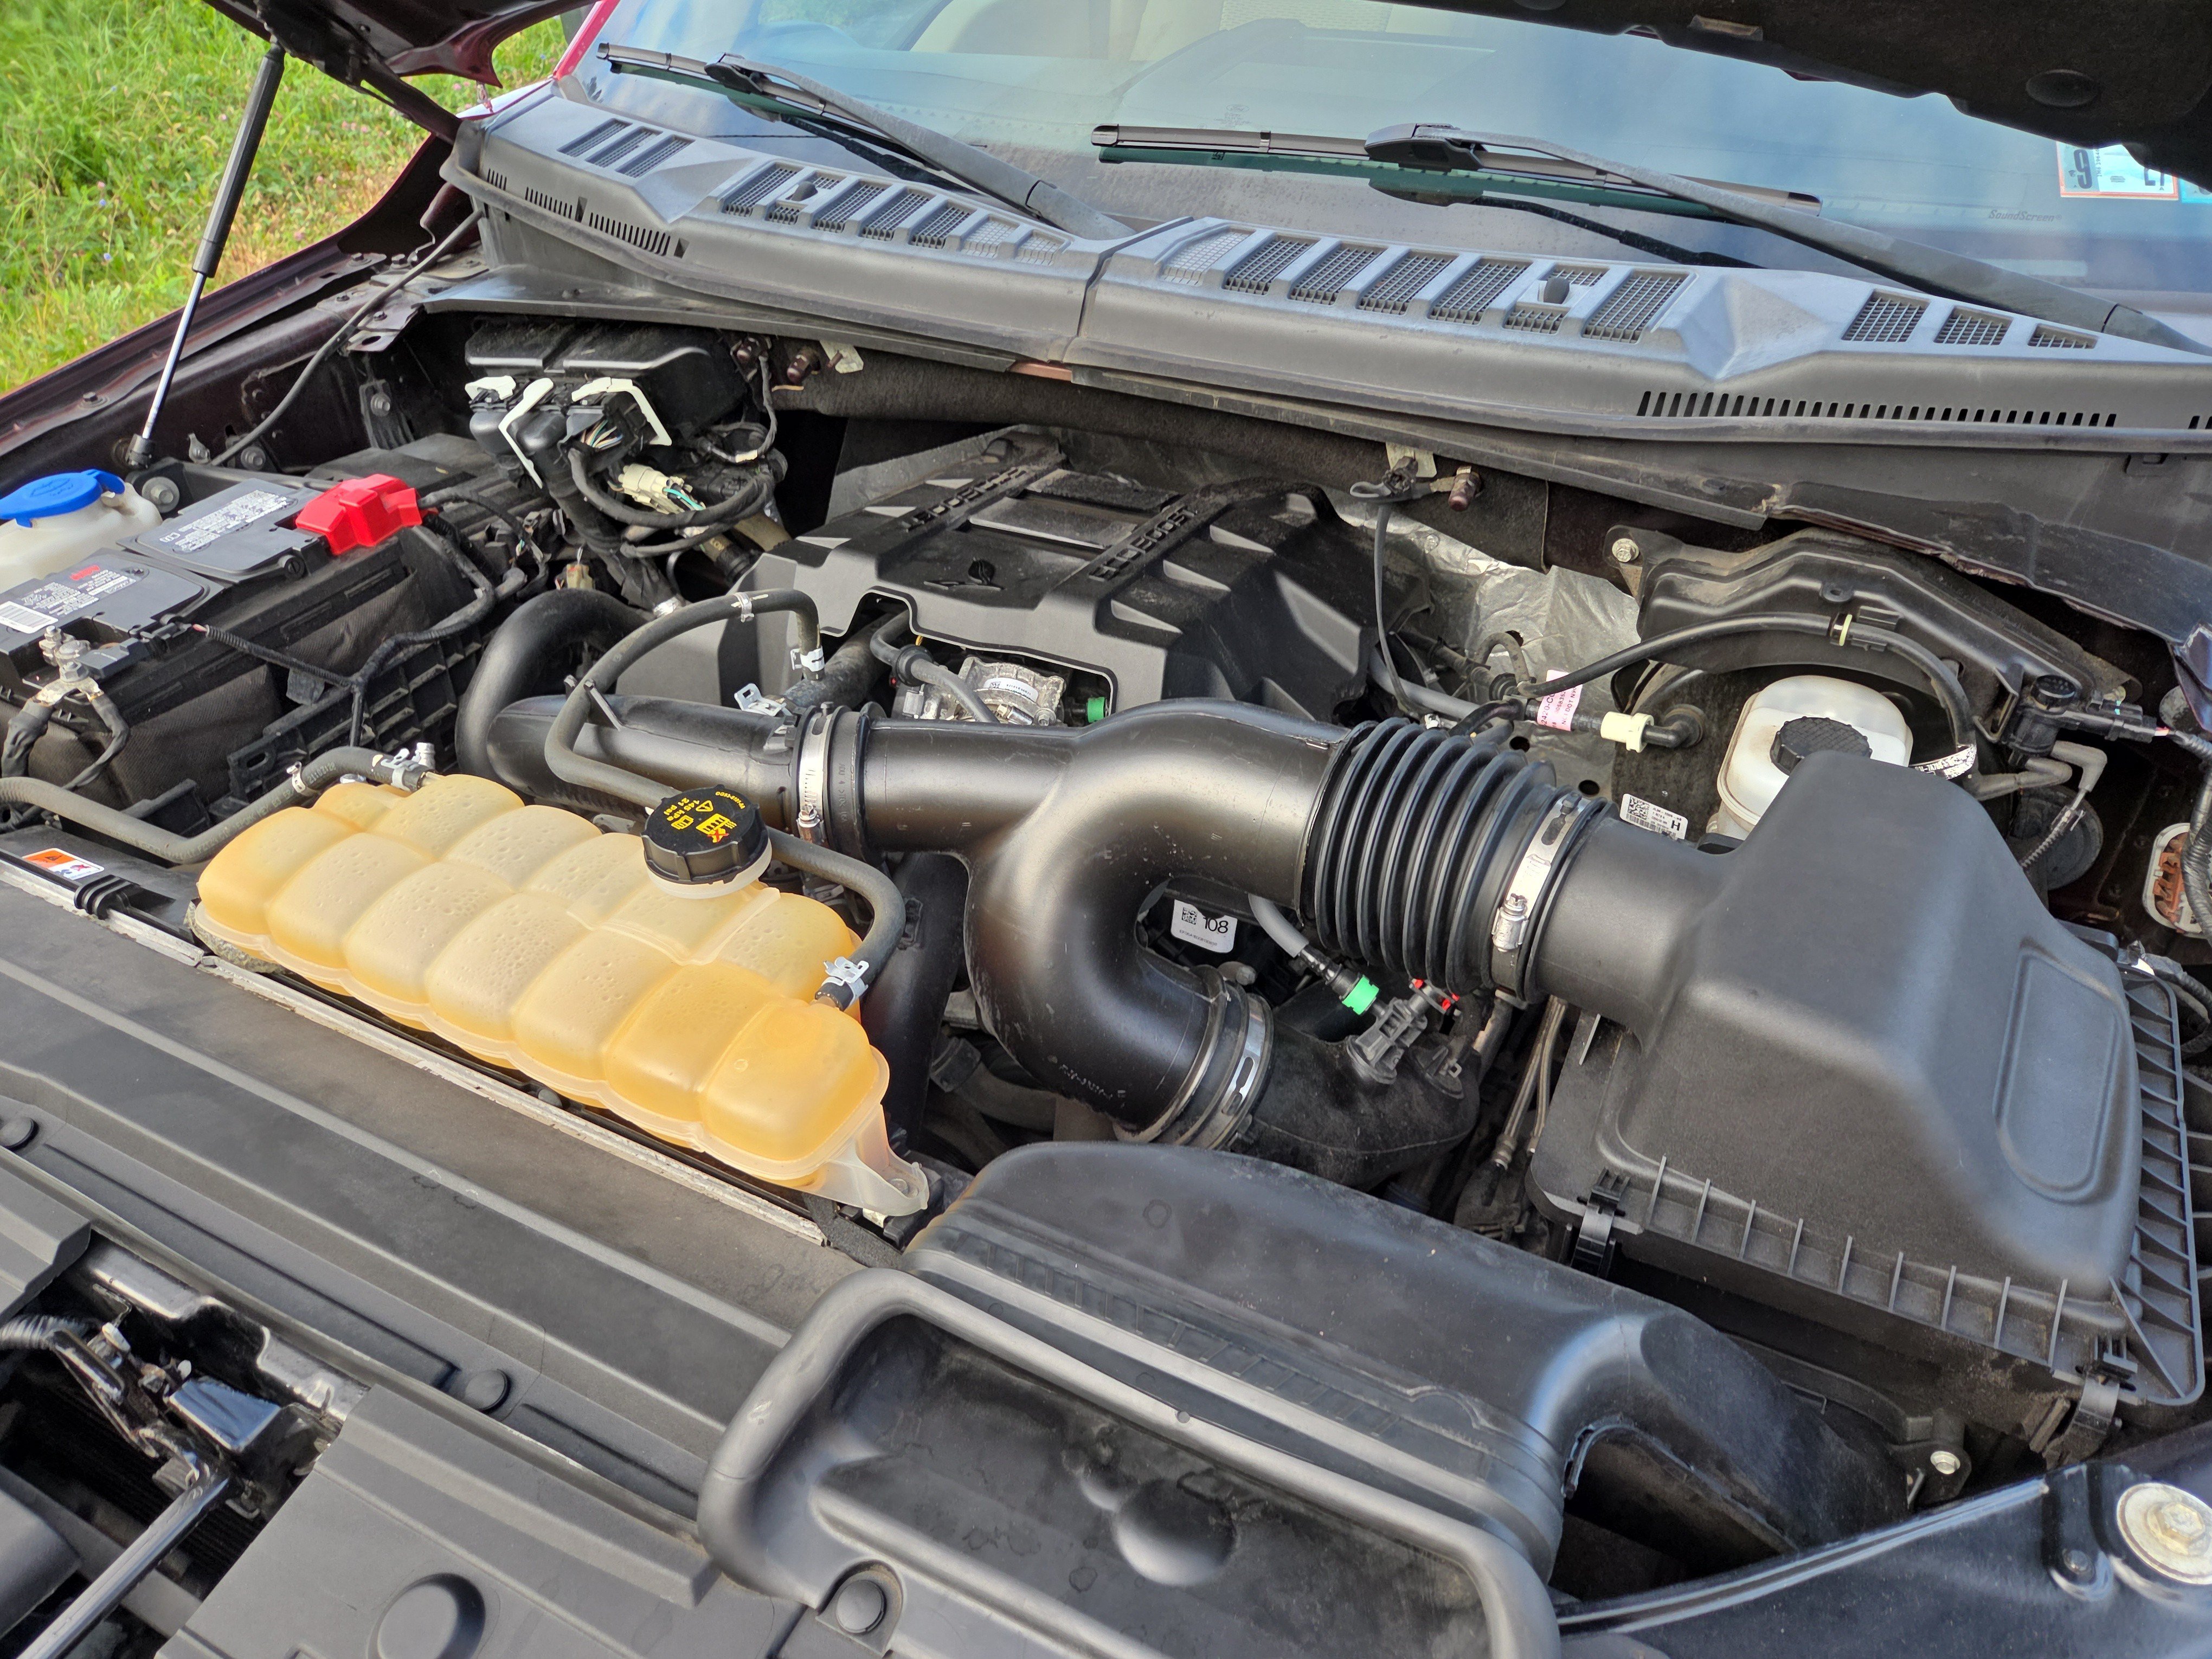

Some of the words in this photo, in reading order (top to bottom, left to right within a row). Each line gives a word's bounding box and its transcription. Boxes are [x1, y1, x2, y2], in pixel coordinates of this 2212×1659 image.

[1088, 504, 1196, 582] ECOBOOST
[677, 797, 690, 807] 21
[683, 800, 700, 812] 145
[1203, 917, 1229, 934] 108
